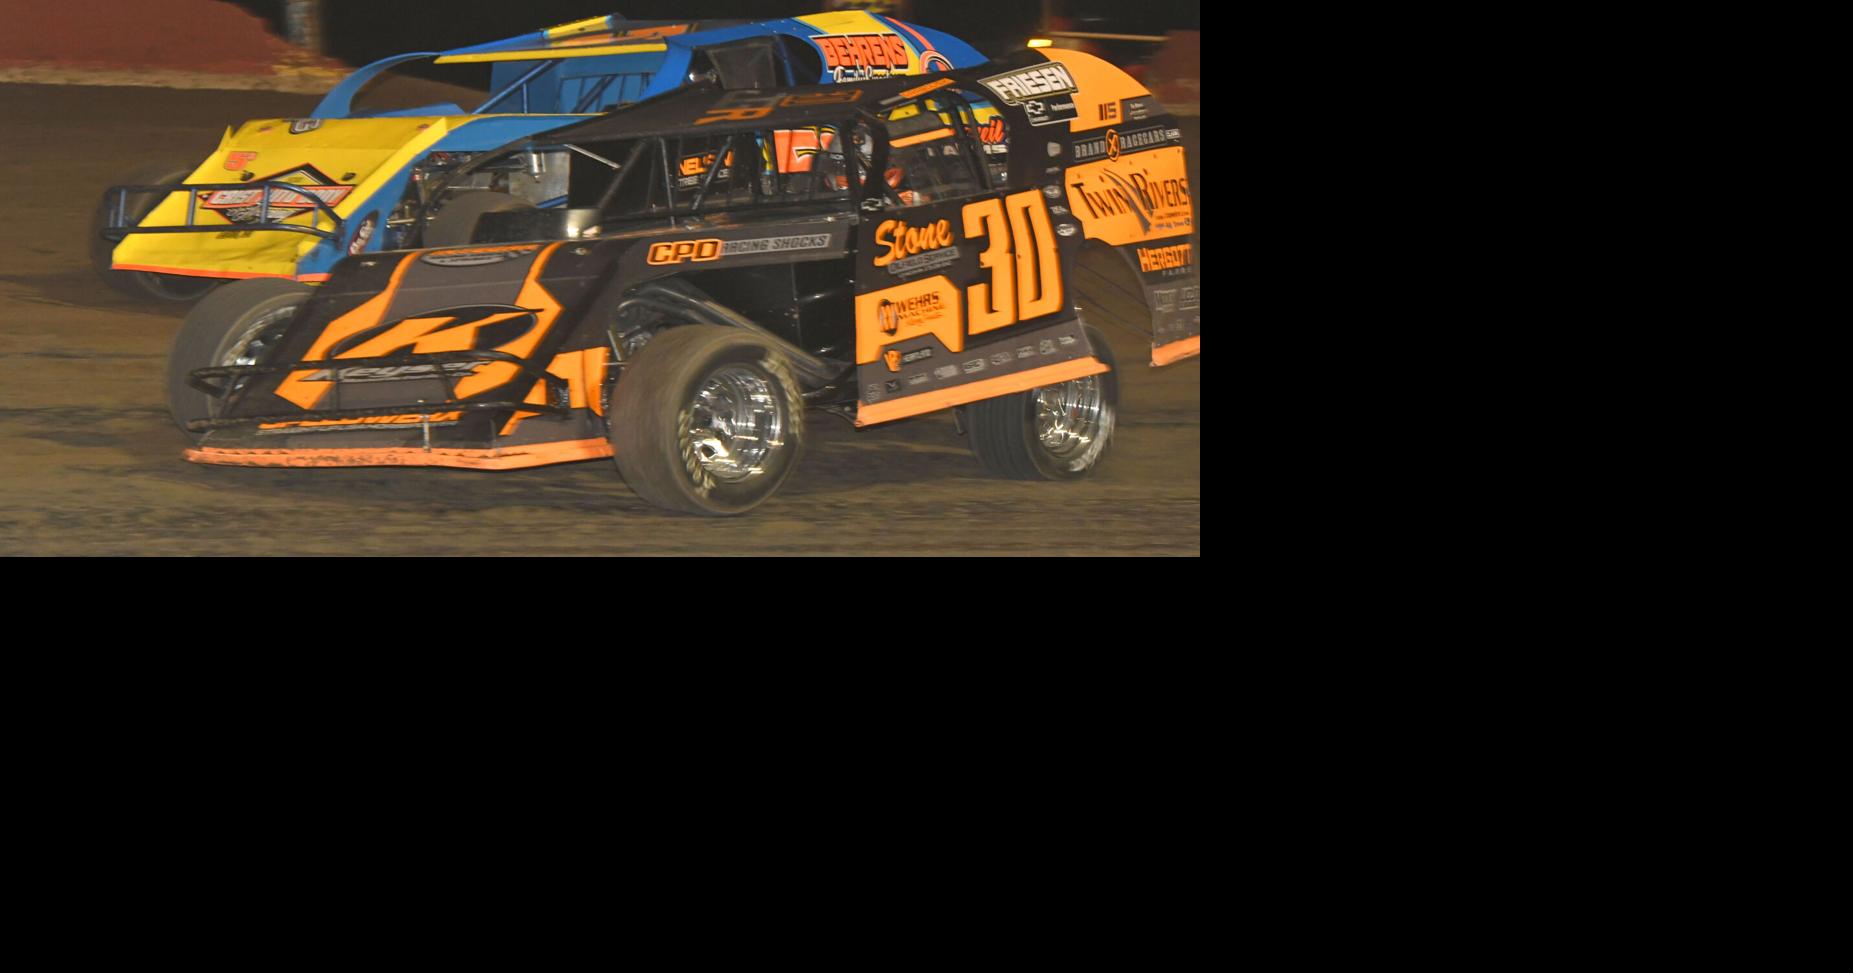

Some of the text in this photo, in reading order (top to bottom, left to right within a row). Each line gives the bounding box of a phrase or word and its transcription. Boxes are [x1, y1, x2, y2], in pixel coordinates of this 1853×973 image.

[812, 33, 908, 68] BEHRENS
[985, 64, 1075, 101] FRIESEN
[1075, 140, 1105, 158] BRAND
[1121, 129, 1166, 149] RACECARS
[647, 235, 828, 264] CPD RACING SHOCKS
[874, 219, 954, 267] Stone
[962, 188, 1064, 336] 30
[895, 291, 940, 313] WEHRS
